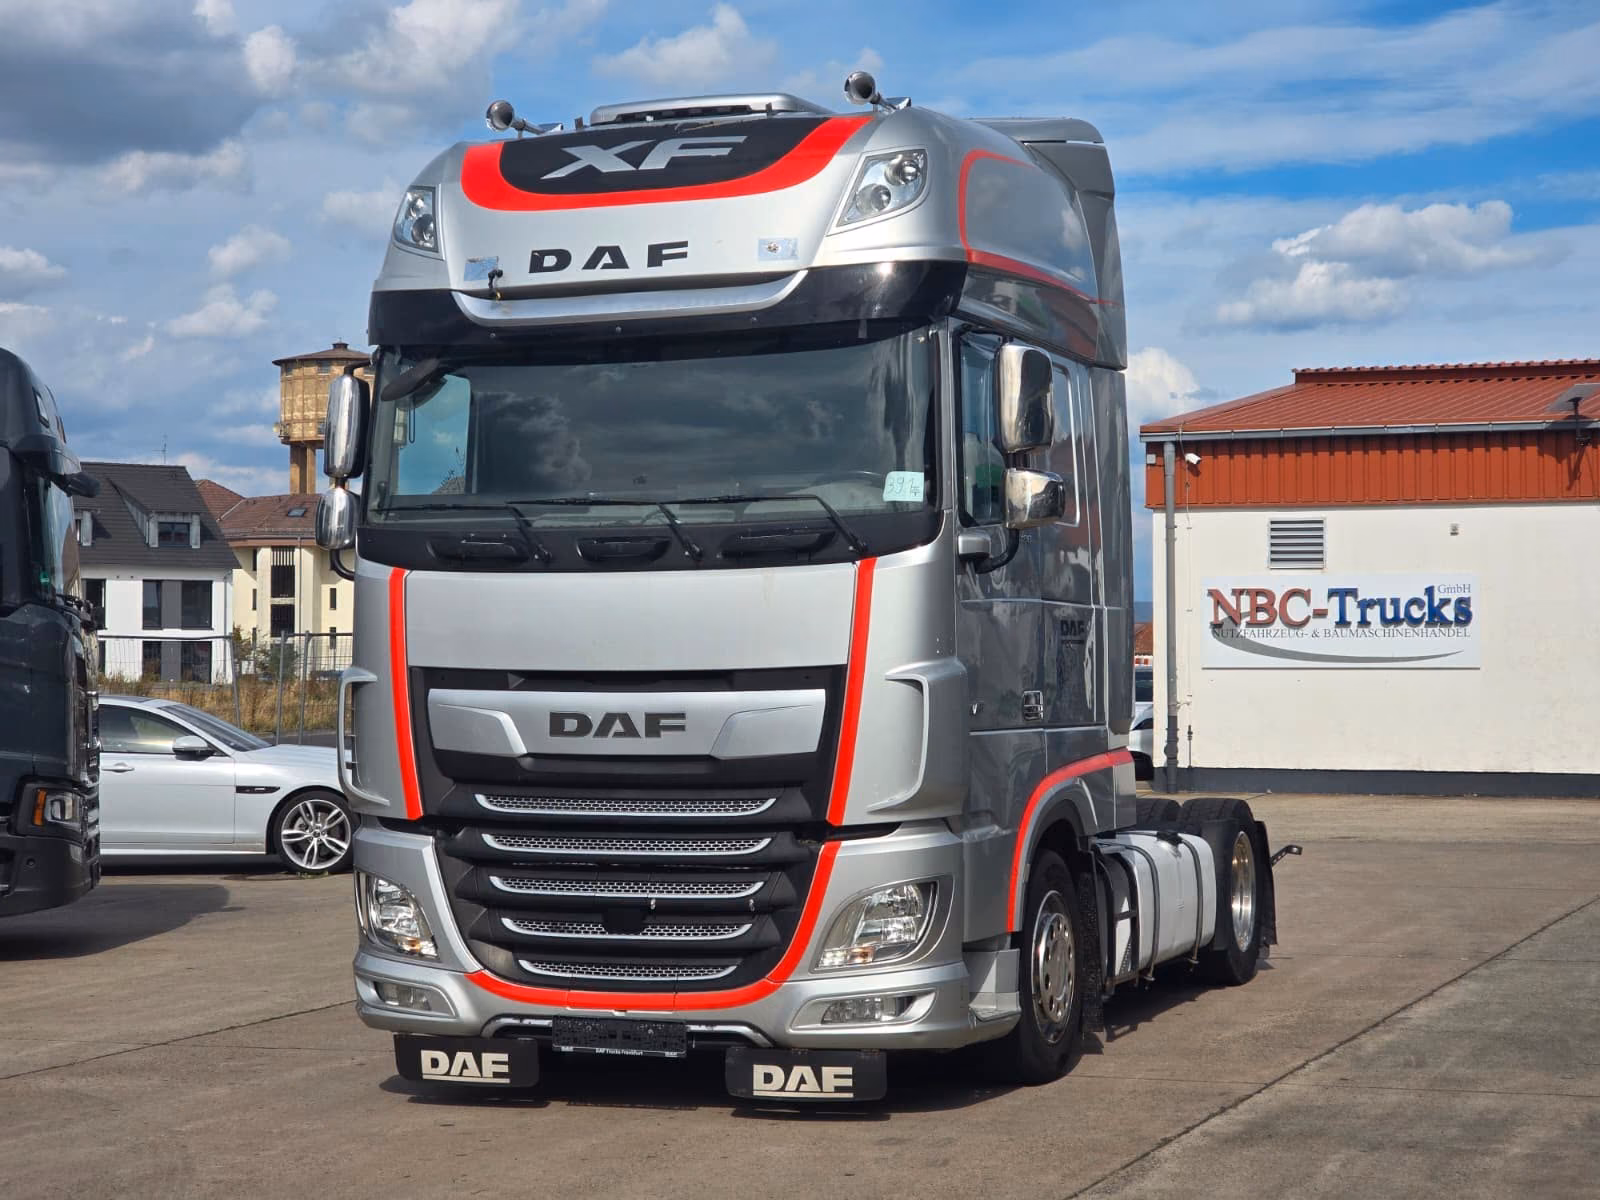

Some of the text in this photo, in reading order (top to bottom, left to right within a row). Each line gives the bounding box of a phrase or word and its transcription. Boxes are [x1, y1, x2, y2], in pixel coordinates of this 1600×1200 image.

[540, 135, 748, 180] XF
[528, 240, 689, 274] DAF
[1207, 584, 1473, 629] NBC-Trucks GmbH
[1060, 620, 1084, 637] DAF
[1311, 628, 1320, 638] &
[1323, 628, 1471, 638] BAUMASCHINENHANDEL
[549, 712, 686, 738] DAF
[420, 1049, 509, 1079] DAF
[753, 1064, 853, 1093] DAF
